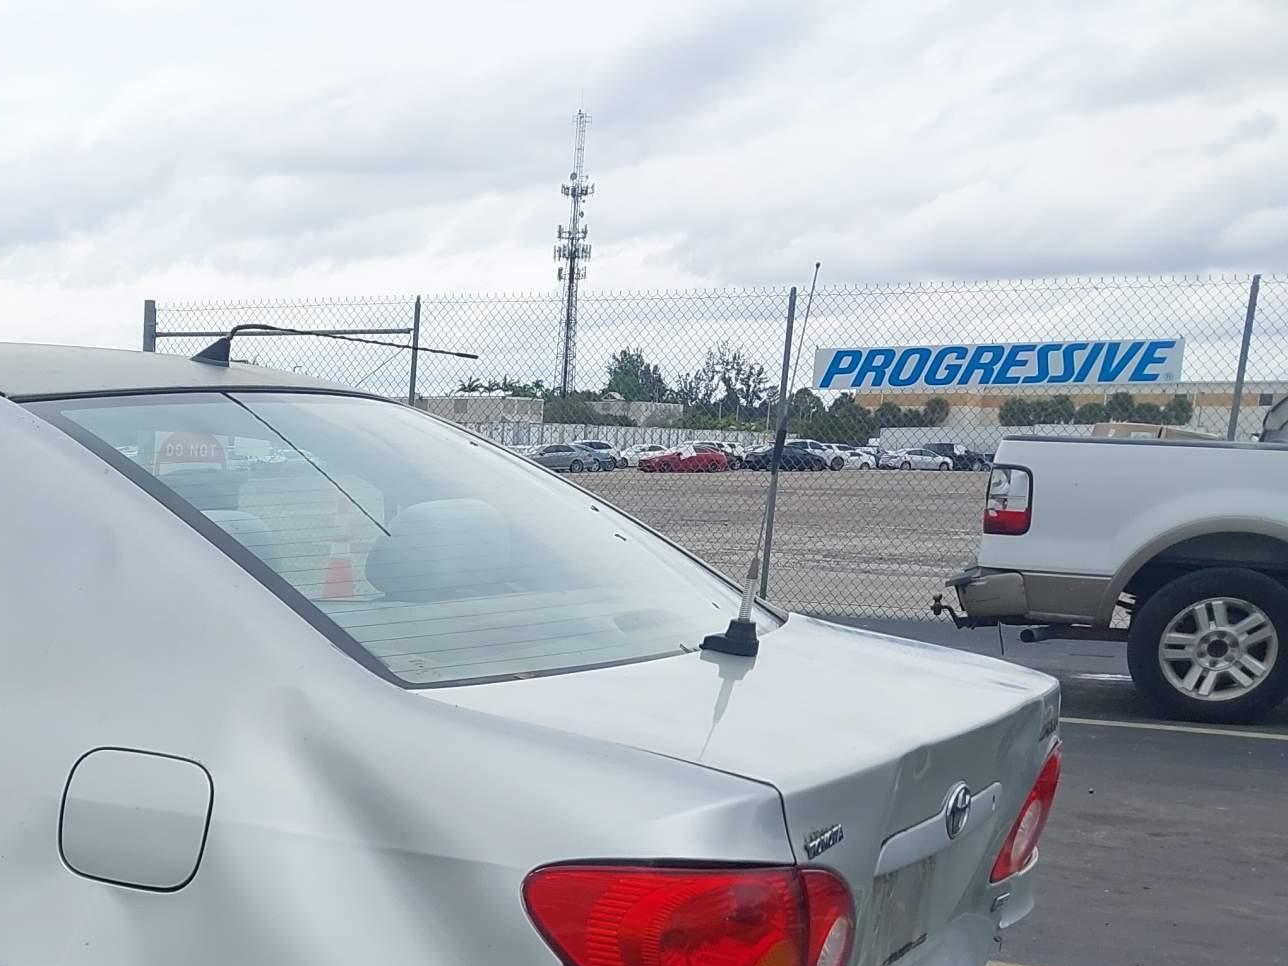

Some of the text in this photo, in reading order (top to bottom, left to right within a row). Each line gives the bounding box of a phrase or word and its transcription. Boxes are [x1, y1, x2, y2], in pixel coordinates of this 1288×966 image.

[819, 340, 1177, 389] PROGRESSIVE
[165, 442, 217, 457] DO NOT
